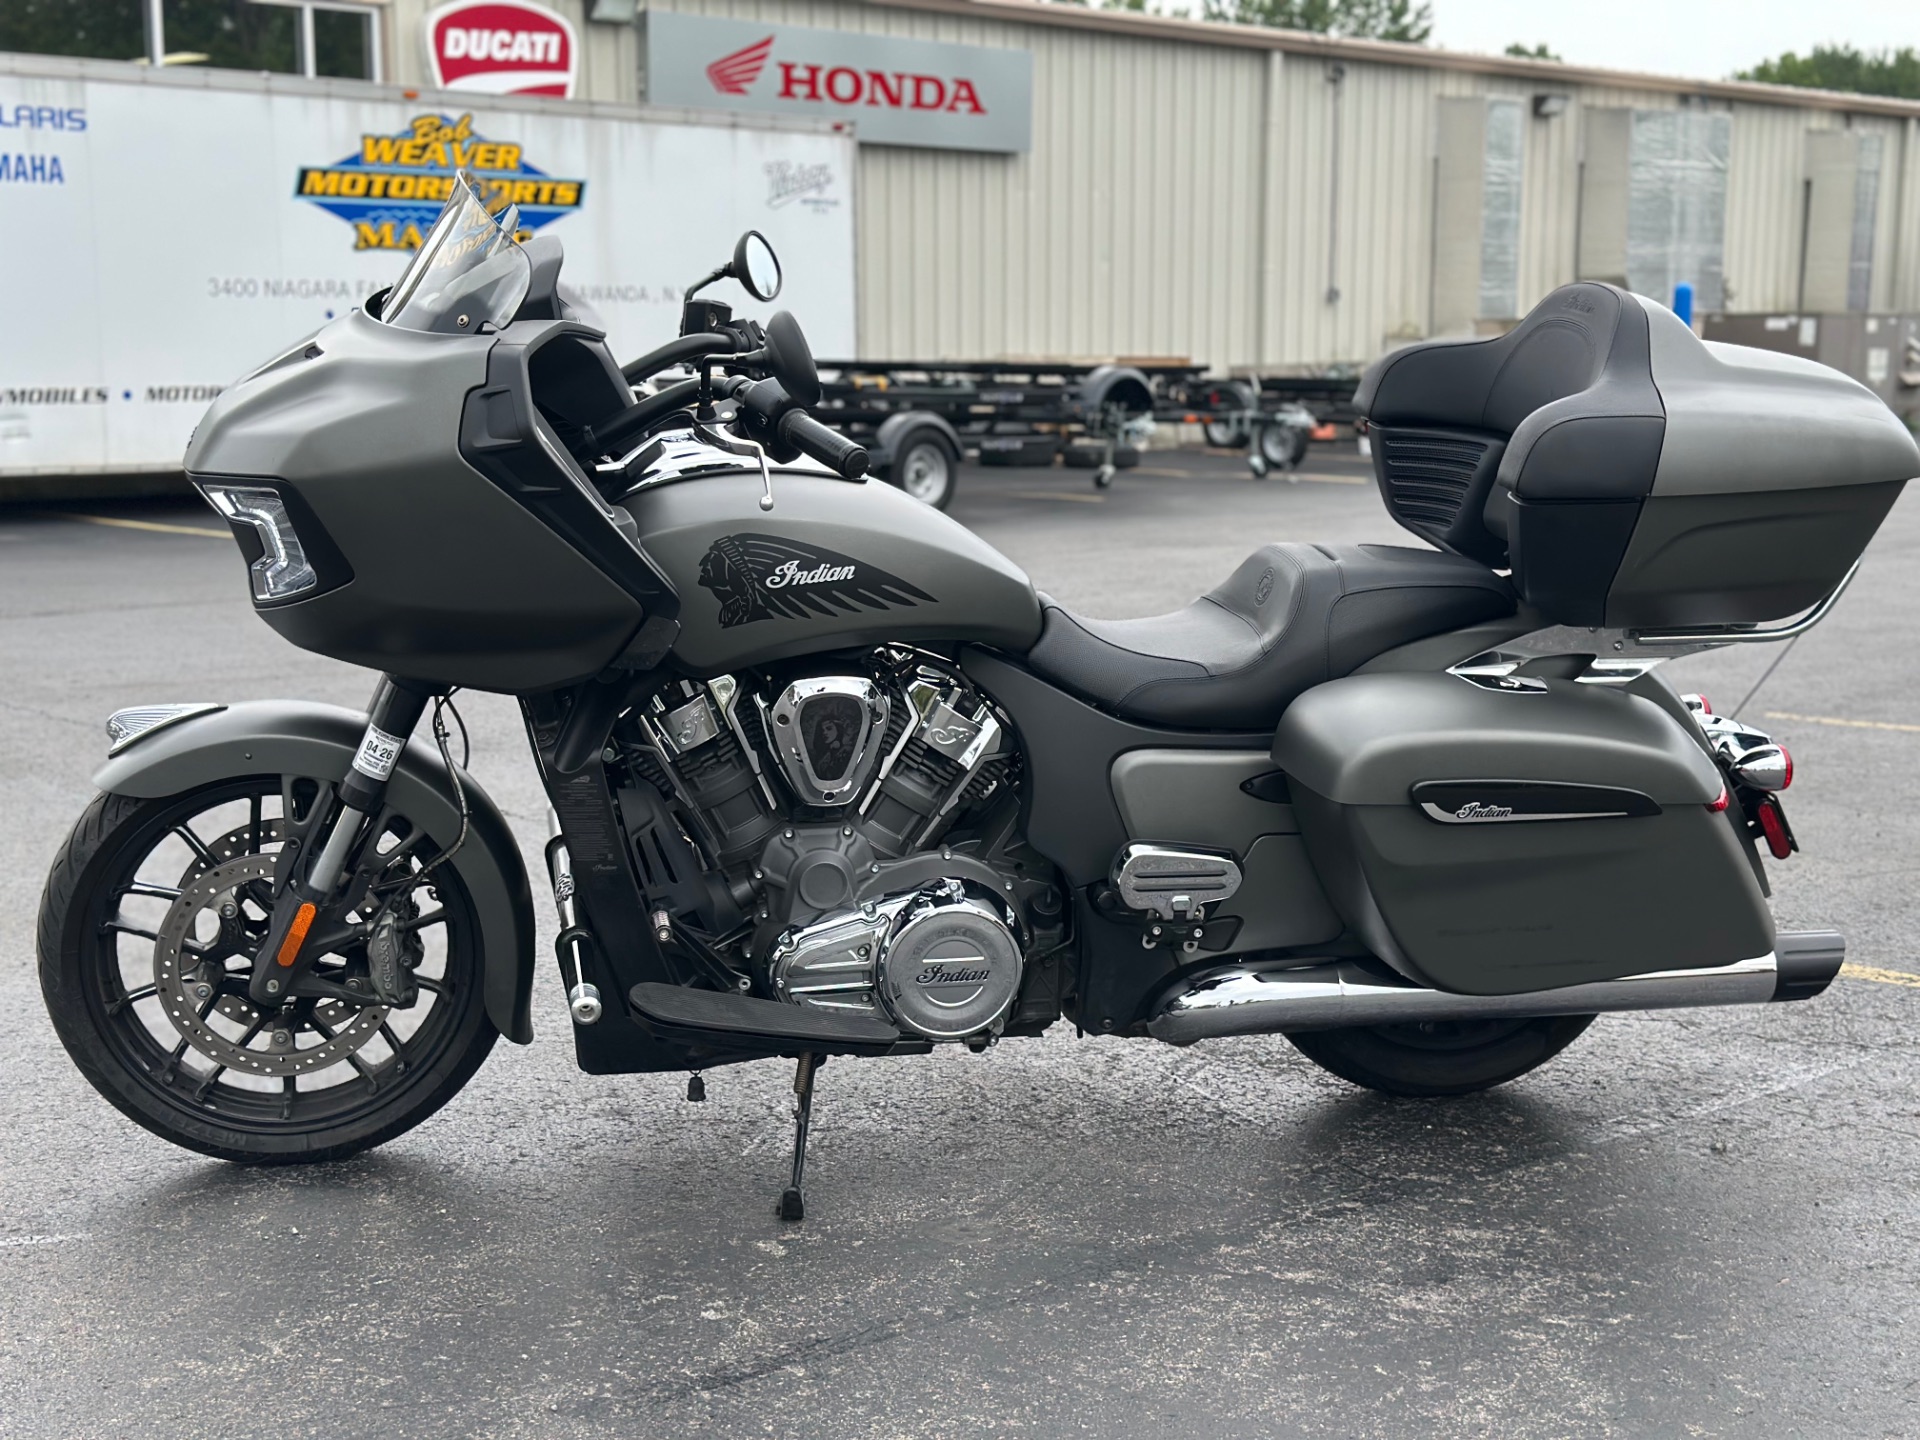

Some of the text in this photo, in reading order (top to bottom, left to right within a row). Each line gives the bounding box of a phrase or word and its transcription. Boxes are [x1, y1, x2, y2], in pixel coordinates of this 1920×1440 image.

[444, 28, 561, 63] DUCATI
[776, 61, 987, 115] HONDA
[411, 113, 473, 143] Bob
[362, 135, 522, 170] WEAVER
[302, 169, 579, 206] MOTORSORTS
[207, 277, 259, 298] 3400
[264, 279, 350, 299] NIAGARA
[0, 385, 226, 404] MOBILES MOTOR
[765, 560, 856, 589] Indian
[366, 740, 378, 754] 04
[379, 747, 394, 760] 26
[1456, 802, 1513, 819] Indian
[379, 941, 394, 990] brembo
[915, 964, 991, 985] Indian
